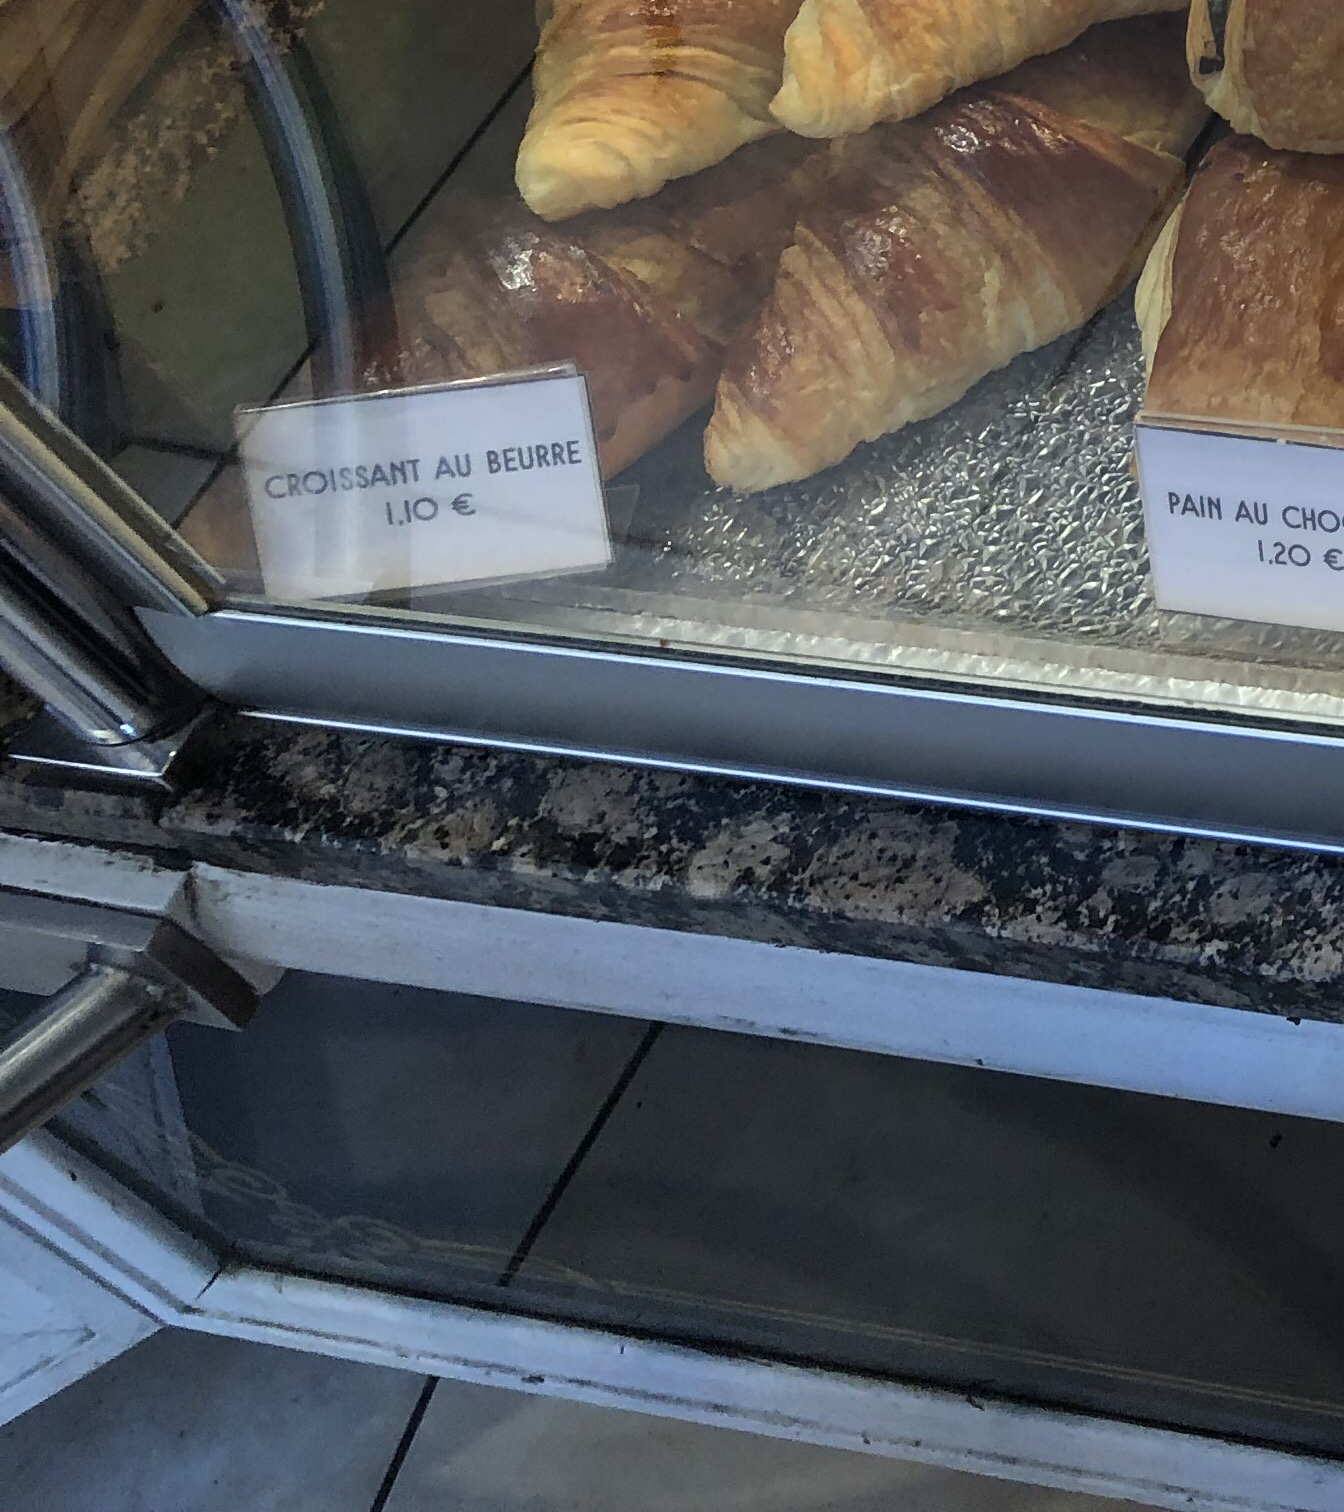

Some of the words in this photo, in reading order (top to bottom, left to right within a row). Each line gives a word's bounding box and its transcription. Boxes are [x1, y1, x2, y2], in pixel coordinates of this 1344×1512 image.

[265, 459, 420, 499] CROISSANT
[435, 453, 471, 480] AU
[486, 440, 582, 474] BEURRE
[385, 497, 439, 526] 1.10
[451, 492, 476, 516] €
[1168, 492, 1223, 521] PAIN
[1235, 500, 1267, 525] AU
[1257, 539, 1311, 567] 1.20
[1323, 548, 1344, 571] €
